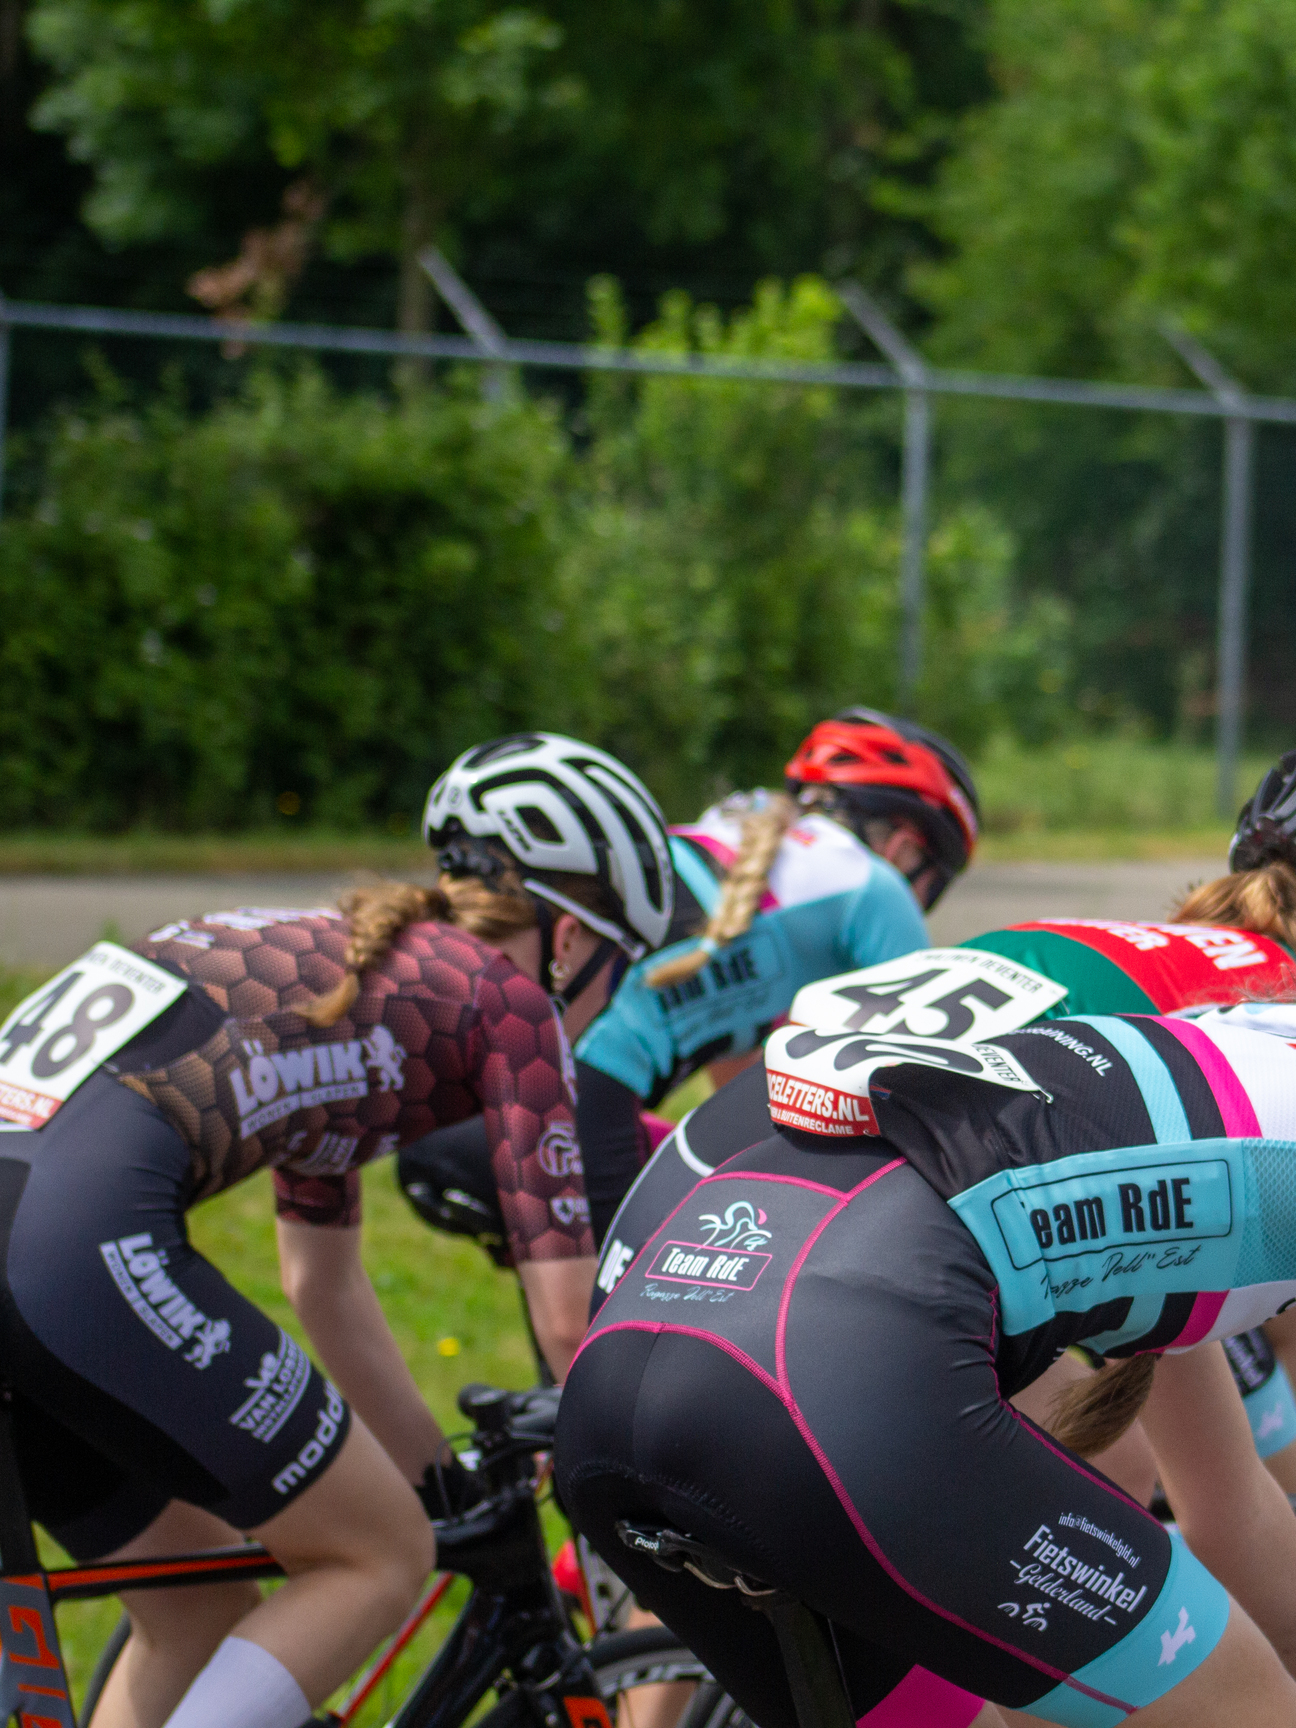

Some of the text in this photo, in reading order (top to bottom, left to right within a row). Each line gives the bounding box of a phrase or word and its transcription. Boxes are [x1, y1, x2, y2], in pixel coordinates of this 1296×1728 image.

[832, 968, 1014, 1042] 45
[981, 958, 1044, 995] DEVENTER
[0, 970, 136, 1080] 48
[230, 1038, 367, 1117] LÖWIK
[782, 1110, 855, 1135] BUITENRECLAME
[1021, 1176, 1195, 1250] eam RdE
[118, 1232, 206, 1339] LÖWIK
[661, 1247, 749, 1281] Team RdE
[1156, 1245, 1201, 1270] Est
[239, 1393, 276, 1430] VAN
[1013, 1563, 1112, 1622] Gelderland
[1023, 1524, 1148, 1613] Fietswinkel
